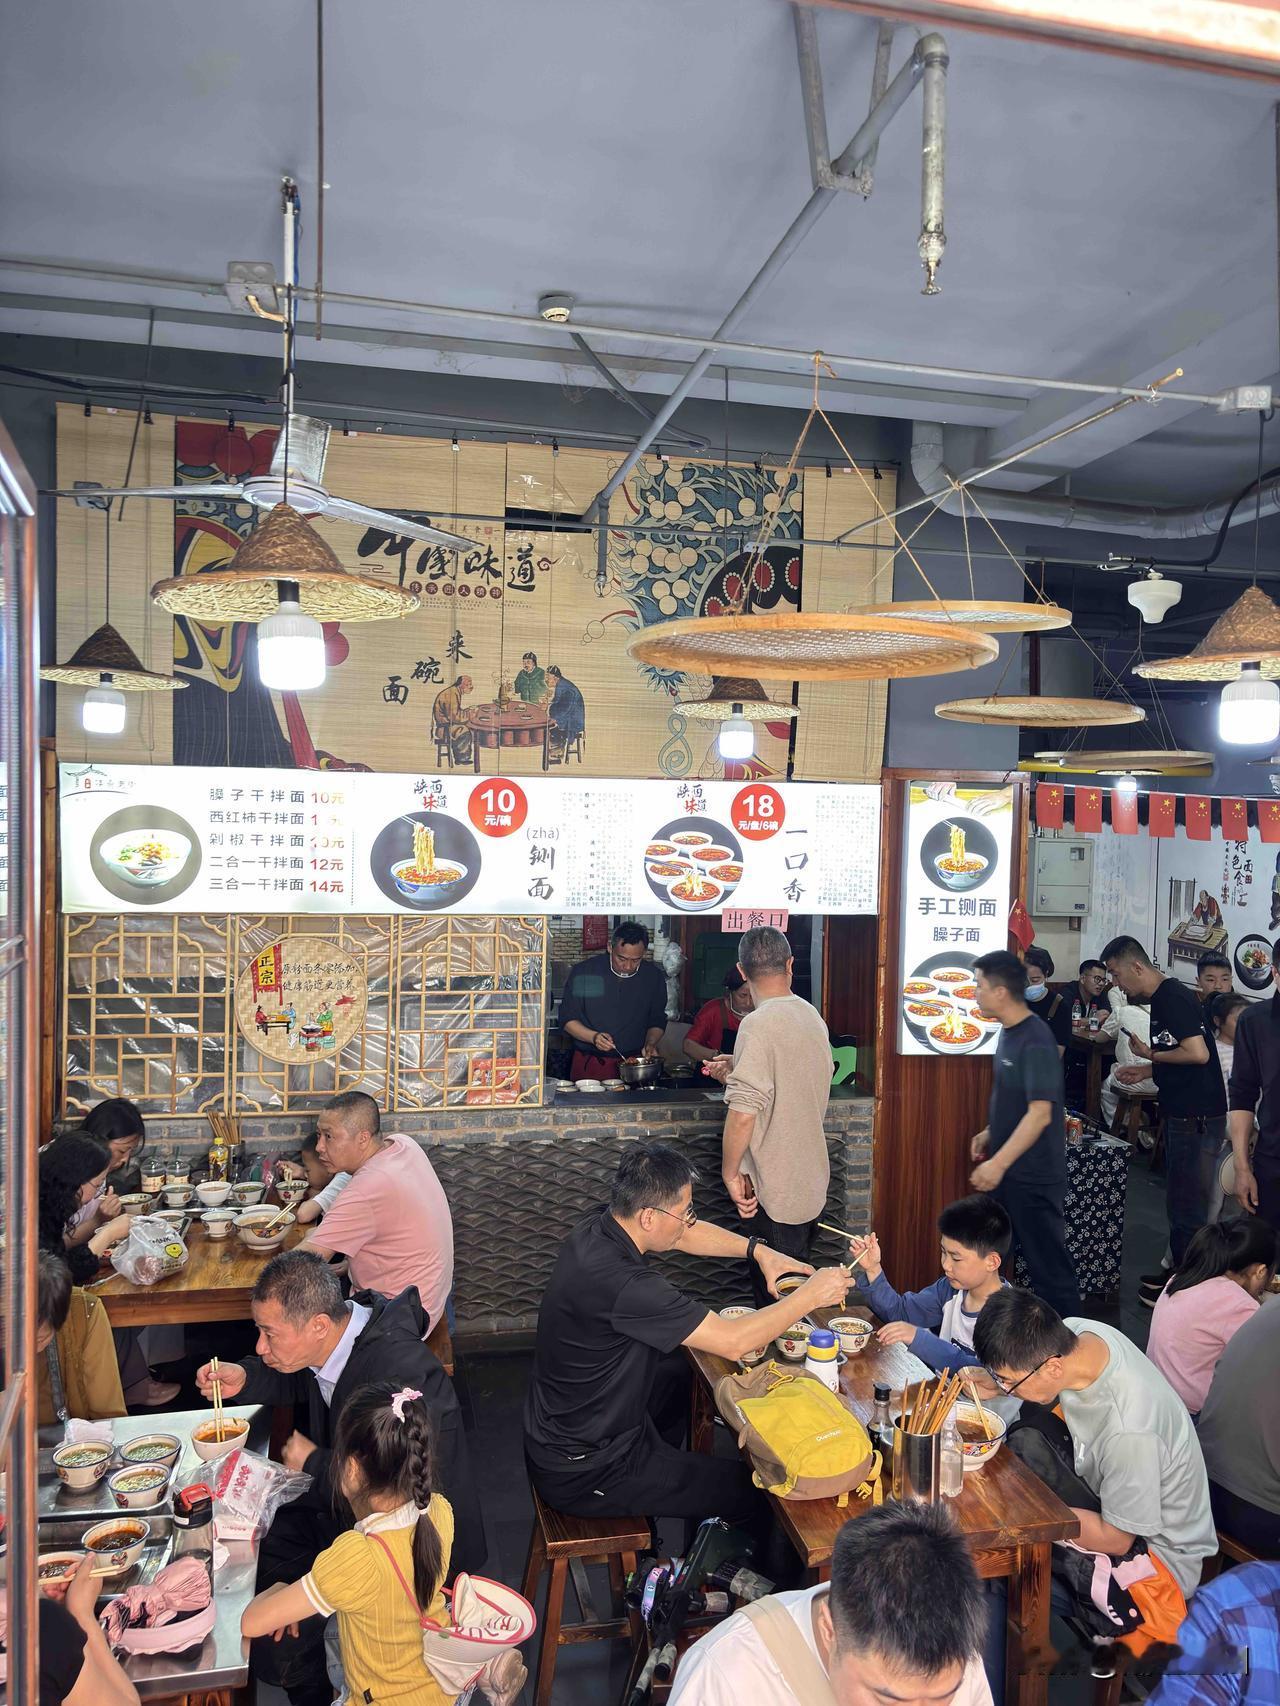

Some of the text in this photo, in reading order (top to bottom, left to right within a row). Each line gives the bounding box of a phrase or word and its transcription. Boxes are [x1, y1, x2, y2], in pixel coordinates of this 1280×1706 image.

[210, 788, 344, 804] 臊子干拌面 10元
[481, 789, 516, 813] 10
[742, 794, 775, 818] 18
[210, 811, 304, 825] 西红柿干拌面
[484, 815, 512, 827] 元/碗
[210, 833, 304, 847] 剁椒干拌面
[210, 855, 343, 870] 二合一干拌面 12元
[783, 829, 809, 903] 一口香
[528, 844, 556, 901] 铡面
[209, 877, 343, 893] 三合一干拌面 14元
[918, 897, 997, 917] 手工铡面
[727, 911, 784, 931] 出餐口
[933, 927, 980, 943] 臊子面
[258, 956, 274, 984] 正宗
